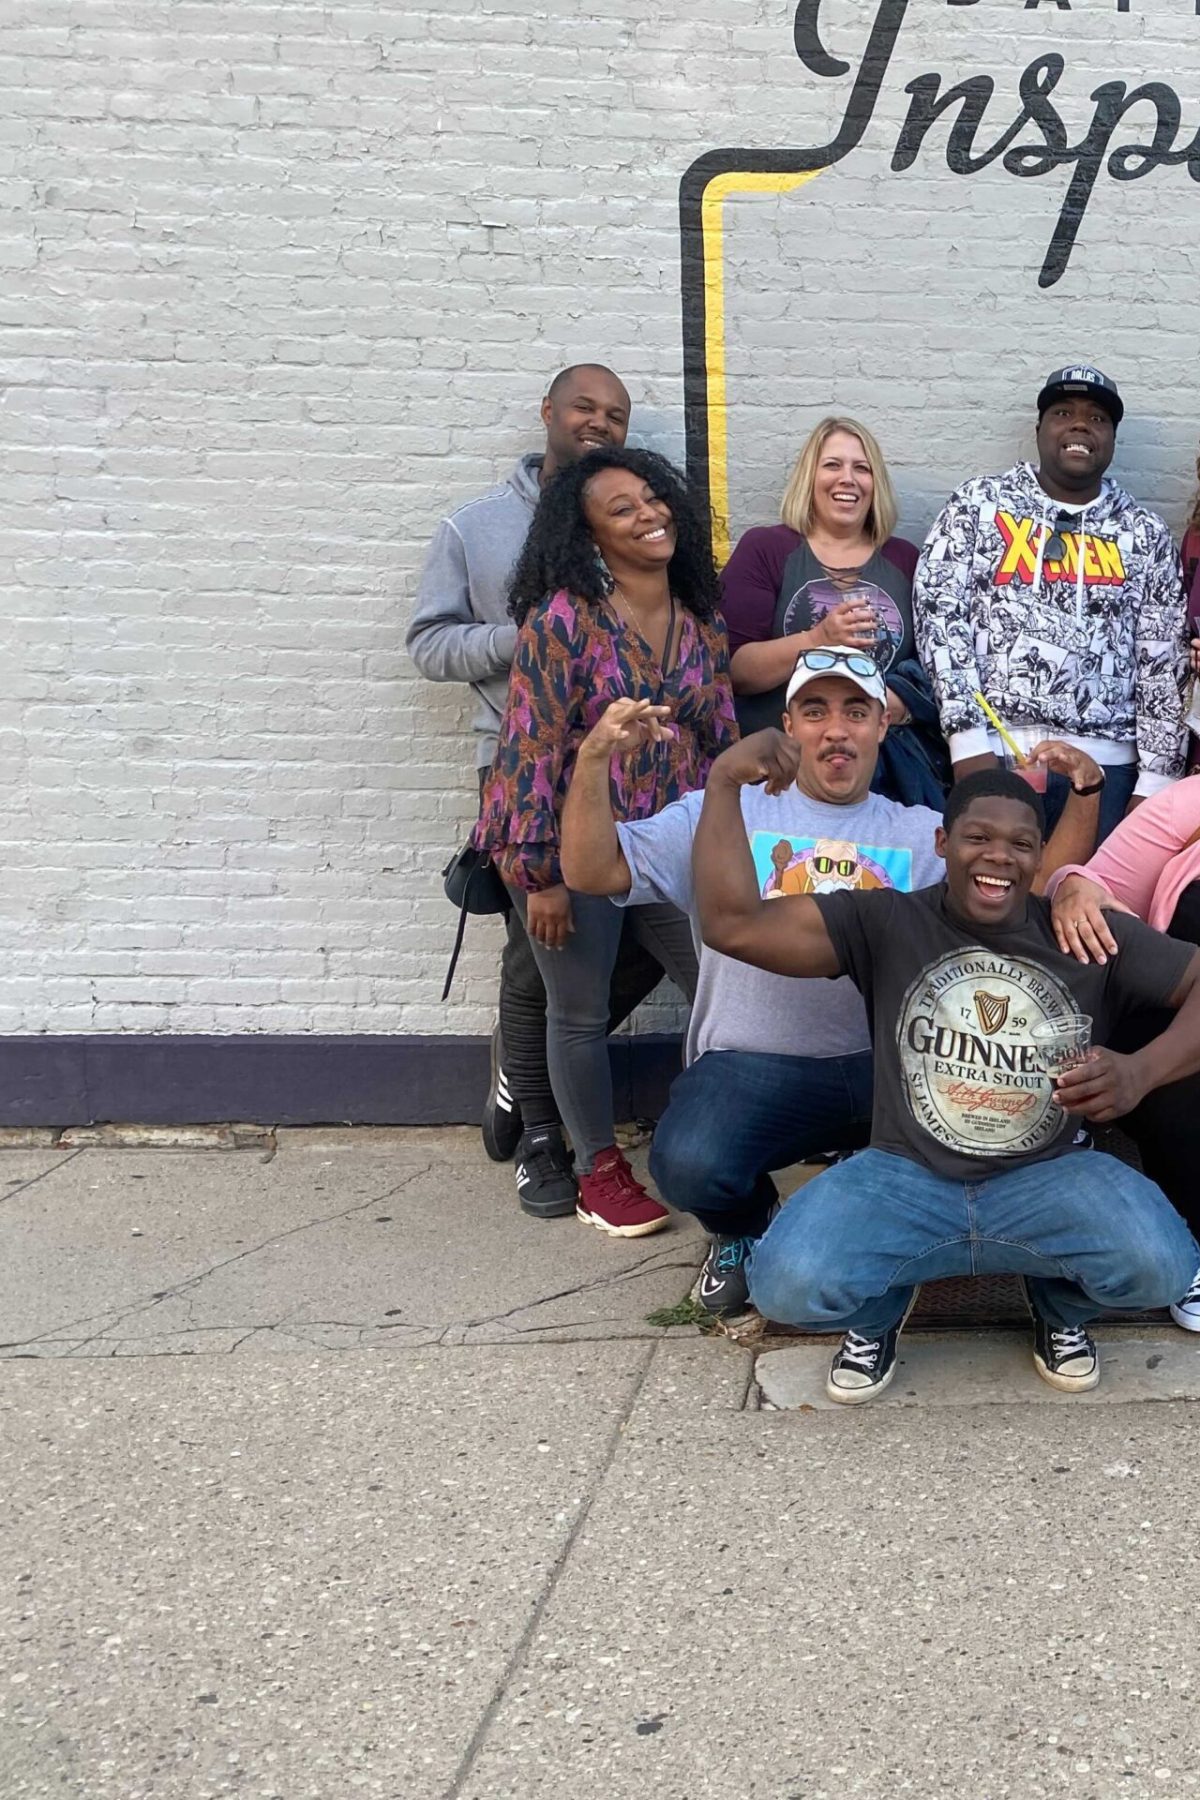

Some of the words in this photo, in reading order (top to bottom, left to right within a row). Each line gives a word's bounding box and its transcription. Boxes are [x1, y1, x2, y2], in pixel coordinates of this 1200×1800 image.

[918, 961, 1027, 1008] TRADITIONALLY
[960, 1007, 972, 1020] 17
[1011, 1017, 1027, 1029] 59
[934, 1061, 988, 1083] EXTRA
[993, 1072, 1044, 1089] STOUT
